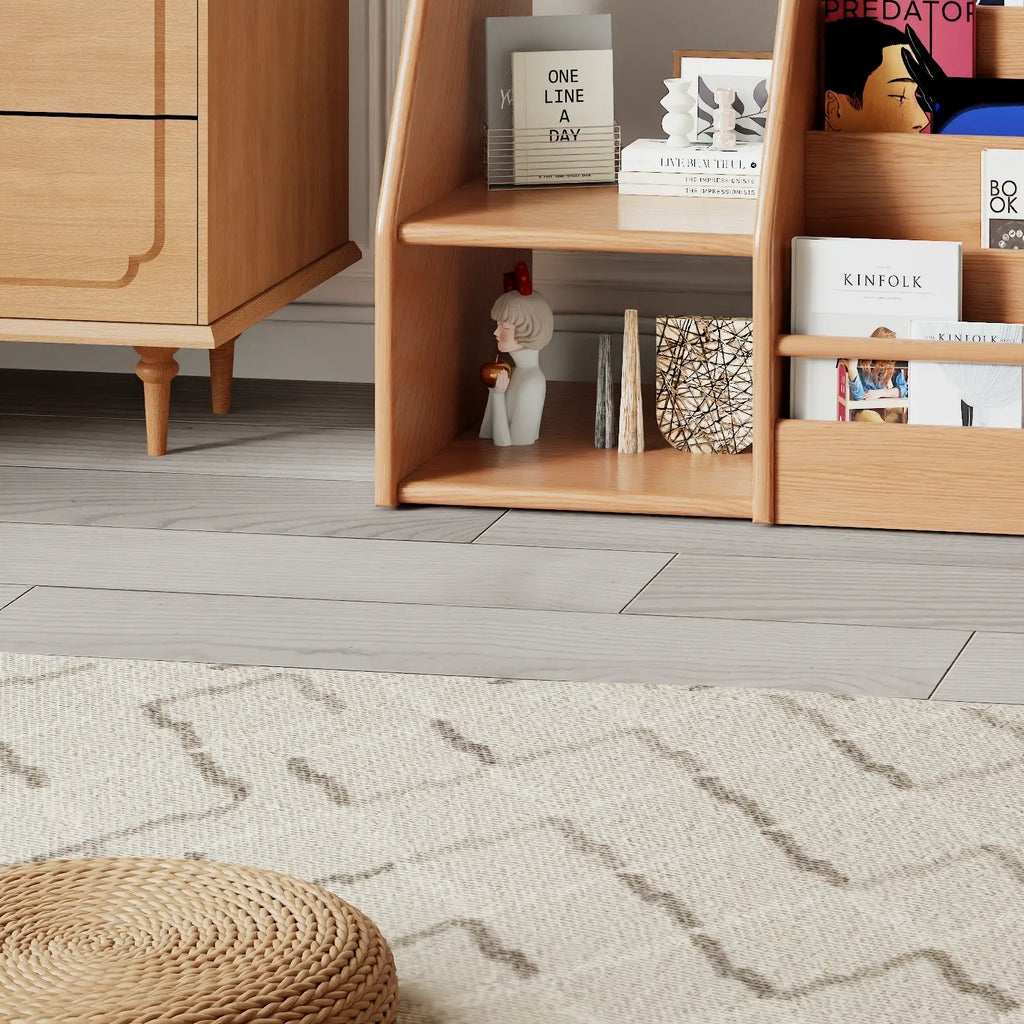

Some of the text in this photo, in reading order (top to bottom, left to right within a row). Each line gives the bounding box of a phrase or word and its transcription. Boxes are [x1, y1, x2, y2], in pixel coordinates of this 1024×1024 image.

[548, 69, 579, 84] ONE
[544, 89, 585, 104] LINE
[559, 109, 570, 123] A
[549, 129, 581, 143] DAY
[990, 179, 1018, 197] BO
[989, 196, 1018, 214] OK
[844, 273, 922, 289] KINFOLK
